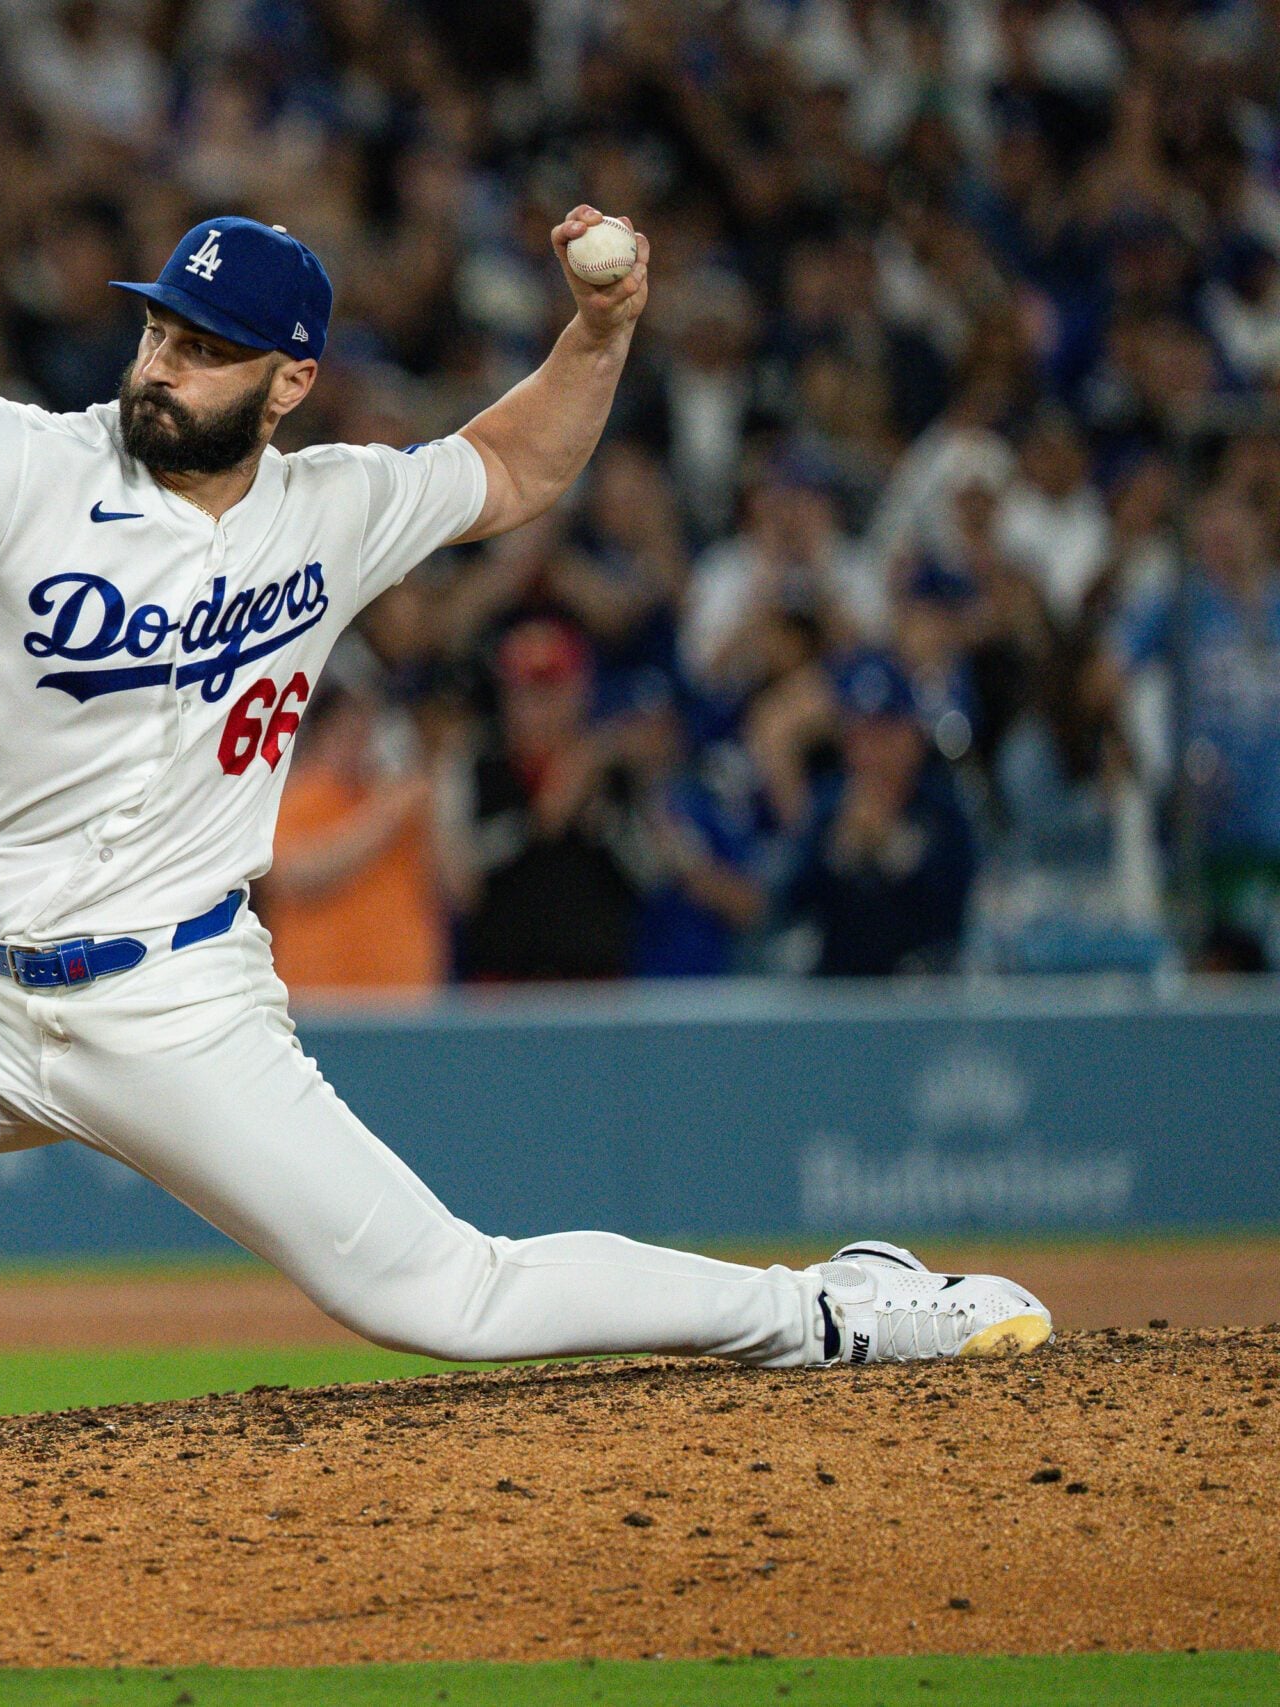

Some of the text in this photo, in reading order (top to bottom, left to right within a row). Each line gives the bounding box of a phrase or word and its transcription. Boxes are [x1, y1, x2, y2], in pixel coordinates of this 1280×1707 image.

[185, 229, 223, 282] LA
[23, 561, 329, 703] Dodgers
[217, 671, 310, 776] 66
[849, 1331, 870, 1365] NIKE
